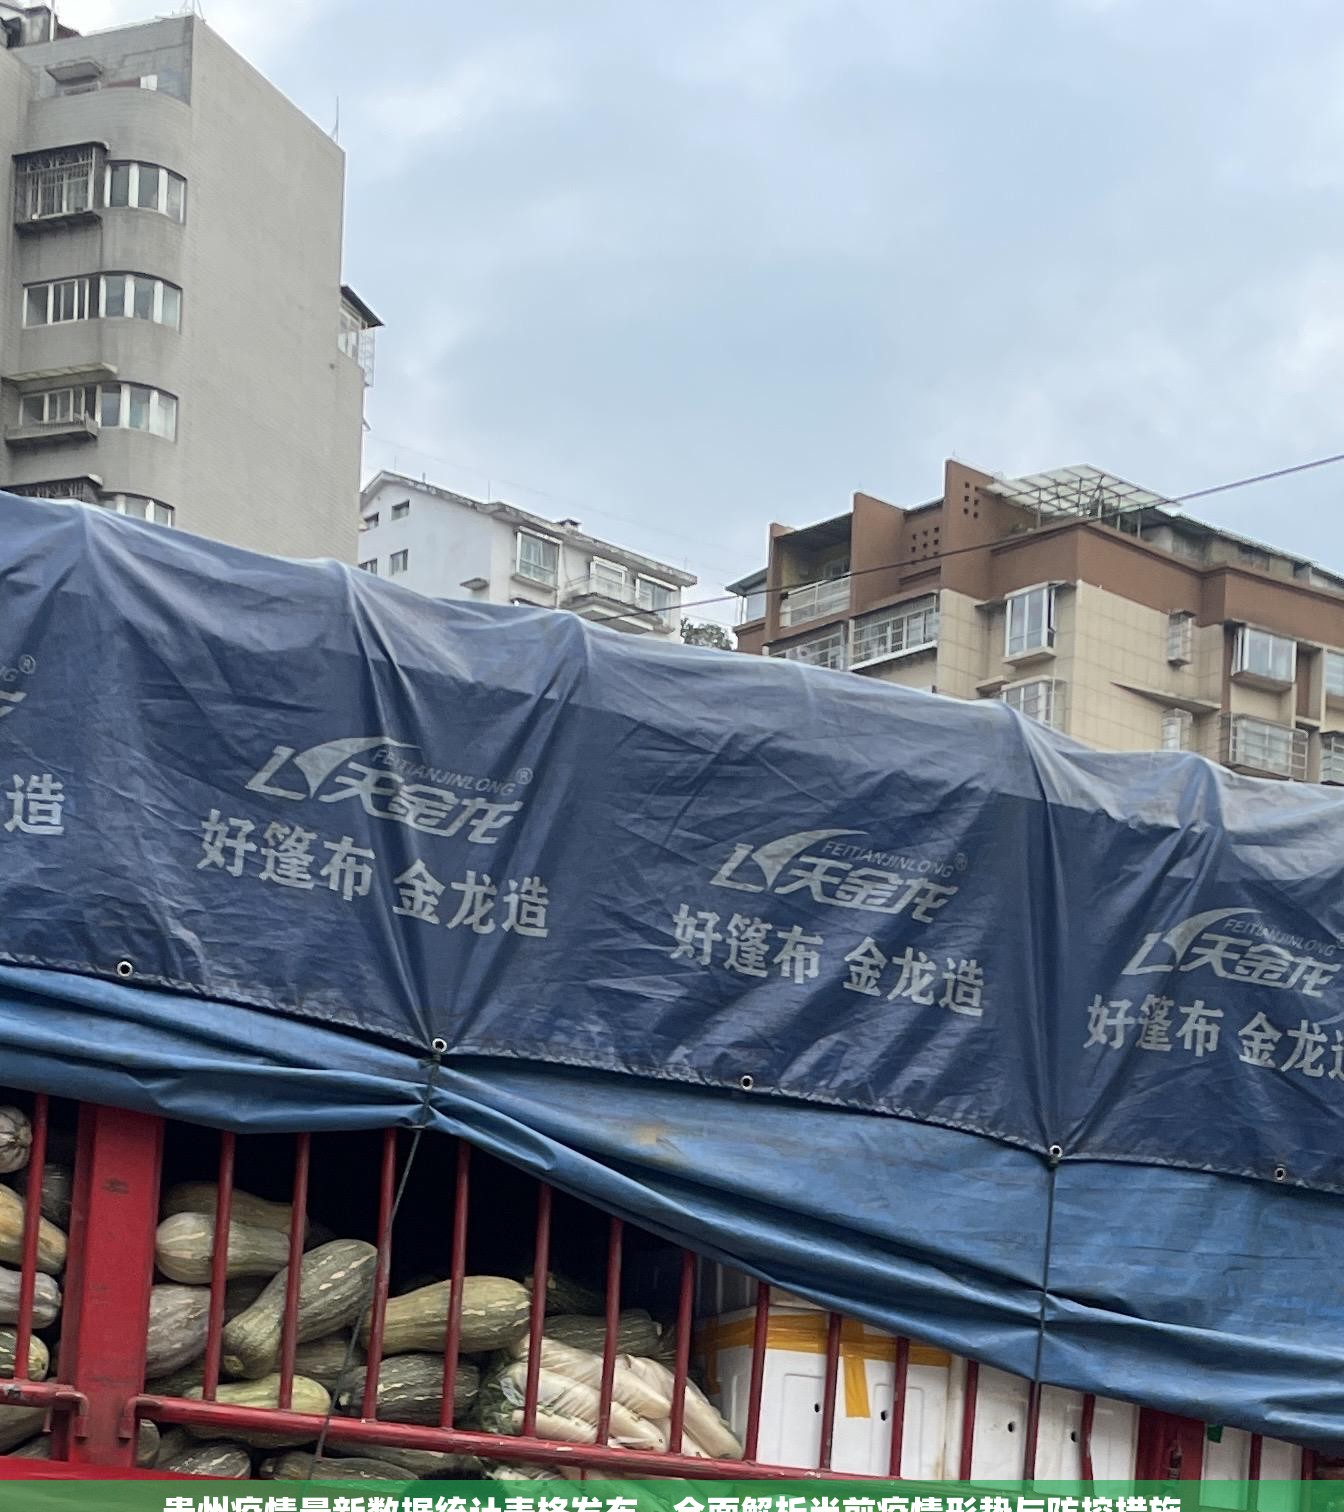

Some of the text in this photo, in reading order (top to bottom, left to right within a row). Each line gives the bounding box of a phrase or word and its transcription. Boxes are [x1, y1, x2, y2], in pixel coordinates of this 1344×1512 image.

[196, 808, 550, 938] 好篷布 金龙造
[669, 903, 985, 1017] 好篷布 金龙造
[1083, 994, 1224, 1057] 好篷布
